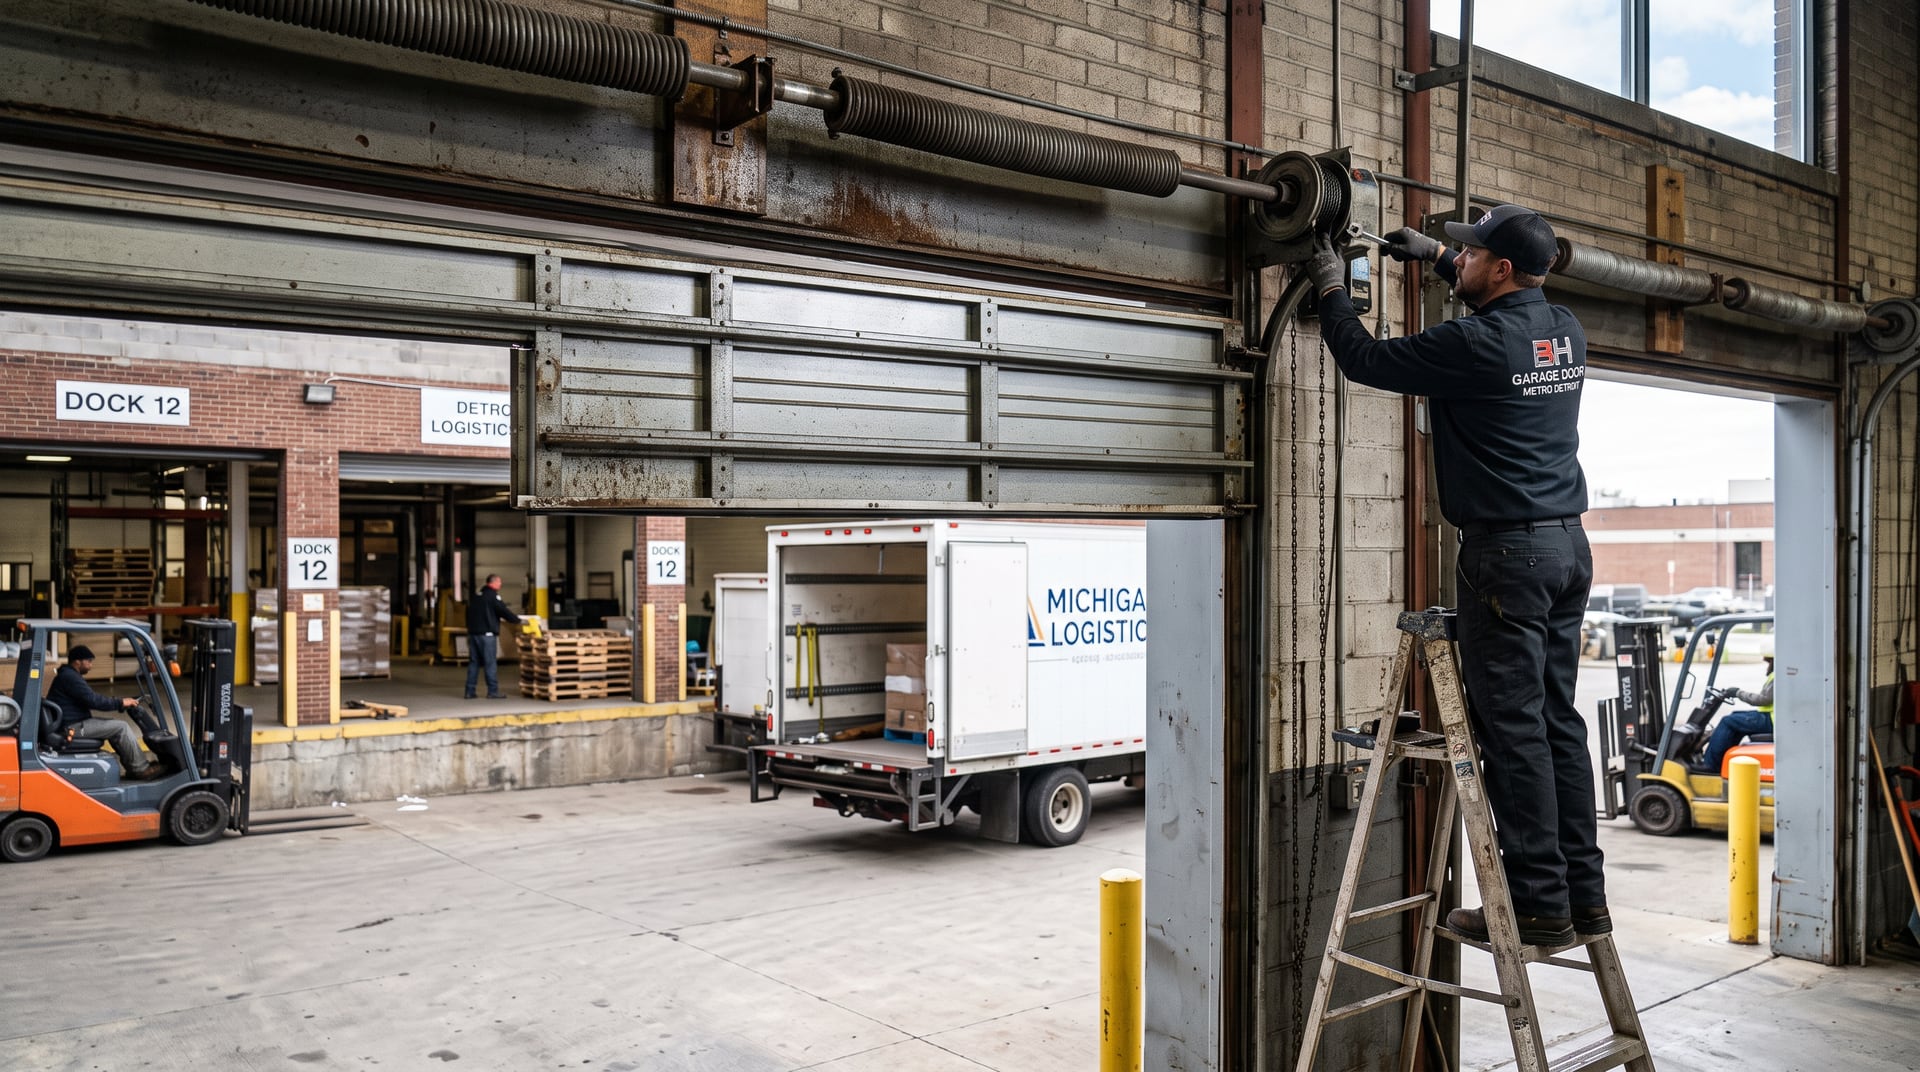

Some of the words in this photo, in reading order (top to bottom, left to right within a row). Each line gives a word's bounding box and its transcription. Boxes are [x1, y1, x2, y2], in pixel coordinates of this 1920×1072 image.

[1512, 369, 1560, 386] GARAGE
[1561, 365, 1585, 380] DOOR
[1522, 384, 1553, 397] METRO
[1553, 380, 1580, 393] DETROIT
[65, 391, 145, 414] DOCK
[154, 396, 181, 416] 12
[457, 401, 511, 417] DETRO
[431, 419, 511, 436] LOGISTIC
[293, 543, 332, 555] DOCK
[651, 546, 680, 556] DOCK
[298, 559, 328, 581] 12
[656, 560, 677, 578] 12
[1047, 587, 1146, 614] MICHIGA
[1051, 619, 1147, 647] LOGISTIC
